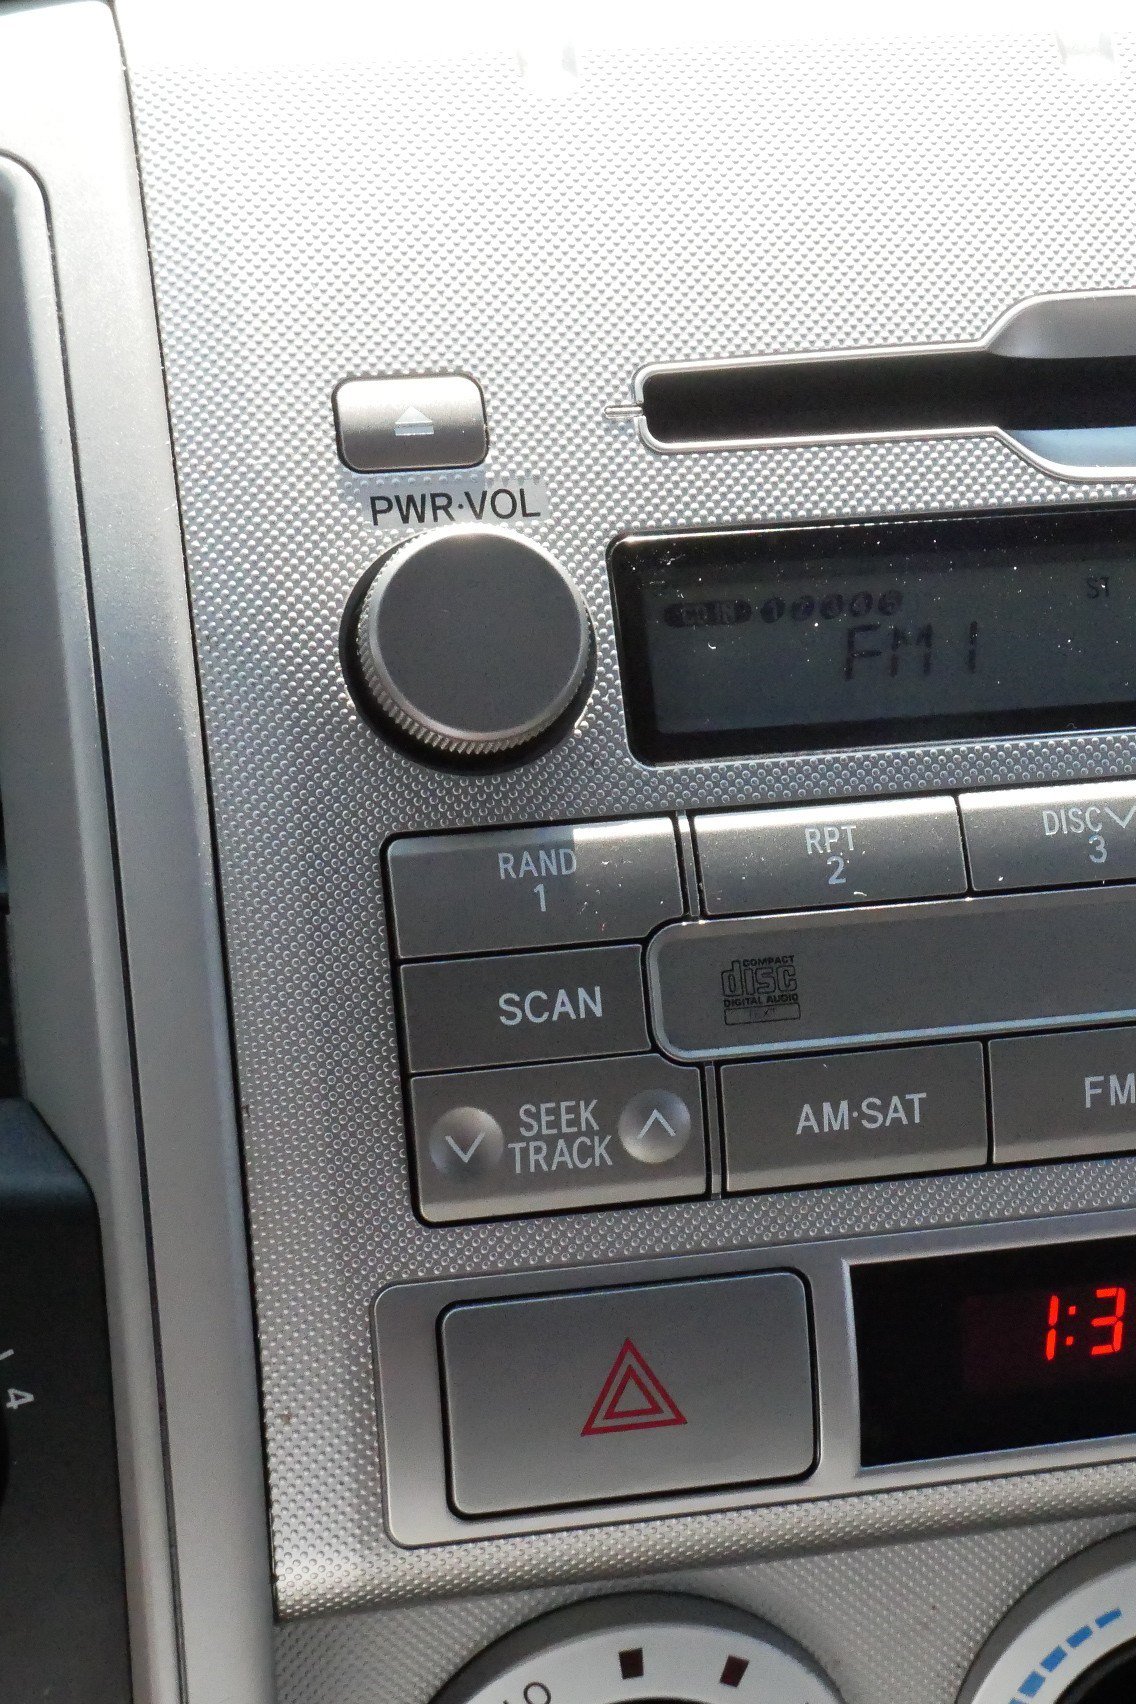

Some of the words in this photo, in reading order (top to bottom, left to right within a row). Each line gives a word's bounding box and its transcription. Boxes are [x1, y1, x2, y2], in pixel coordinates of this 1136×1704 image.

[1042, 808, 1101, 837] DISC
[805, 825, 857, 854] RPT
[1088, 835, 1107, 863] 3
[499, 848, 577, 879] RAND
[827, 856, 847, 885] 2
[533, 884, 547, 912] 1
[742, 955, 795, 967] COMPACT
[499, 986, 603, 1025] SCAN
[723, 996, 763, 1008] DIGITAL
[766, 993, 799, 1004] AUDIO
[519, 1099, 599, 1137] SEEK
[508, 1134, 613, 1174] TRACK
